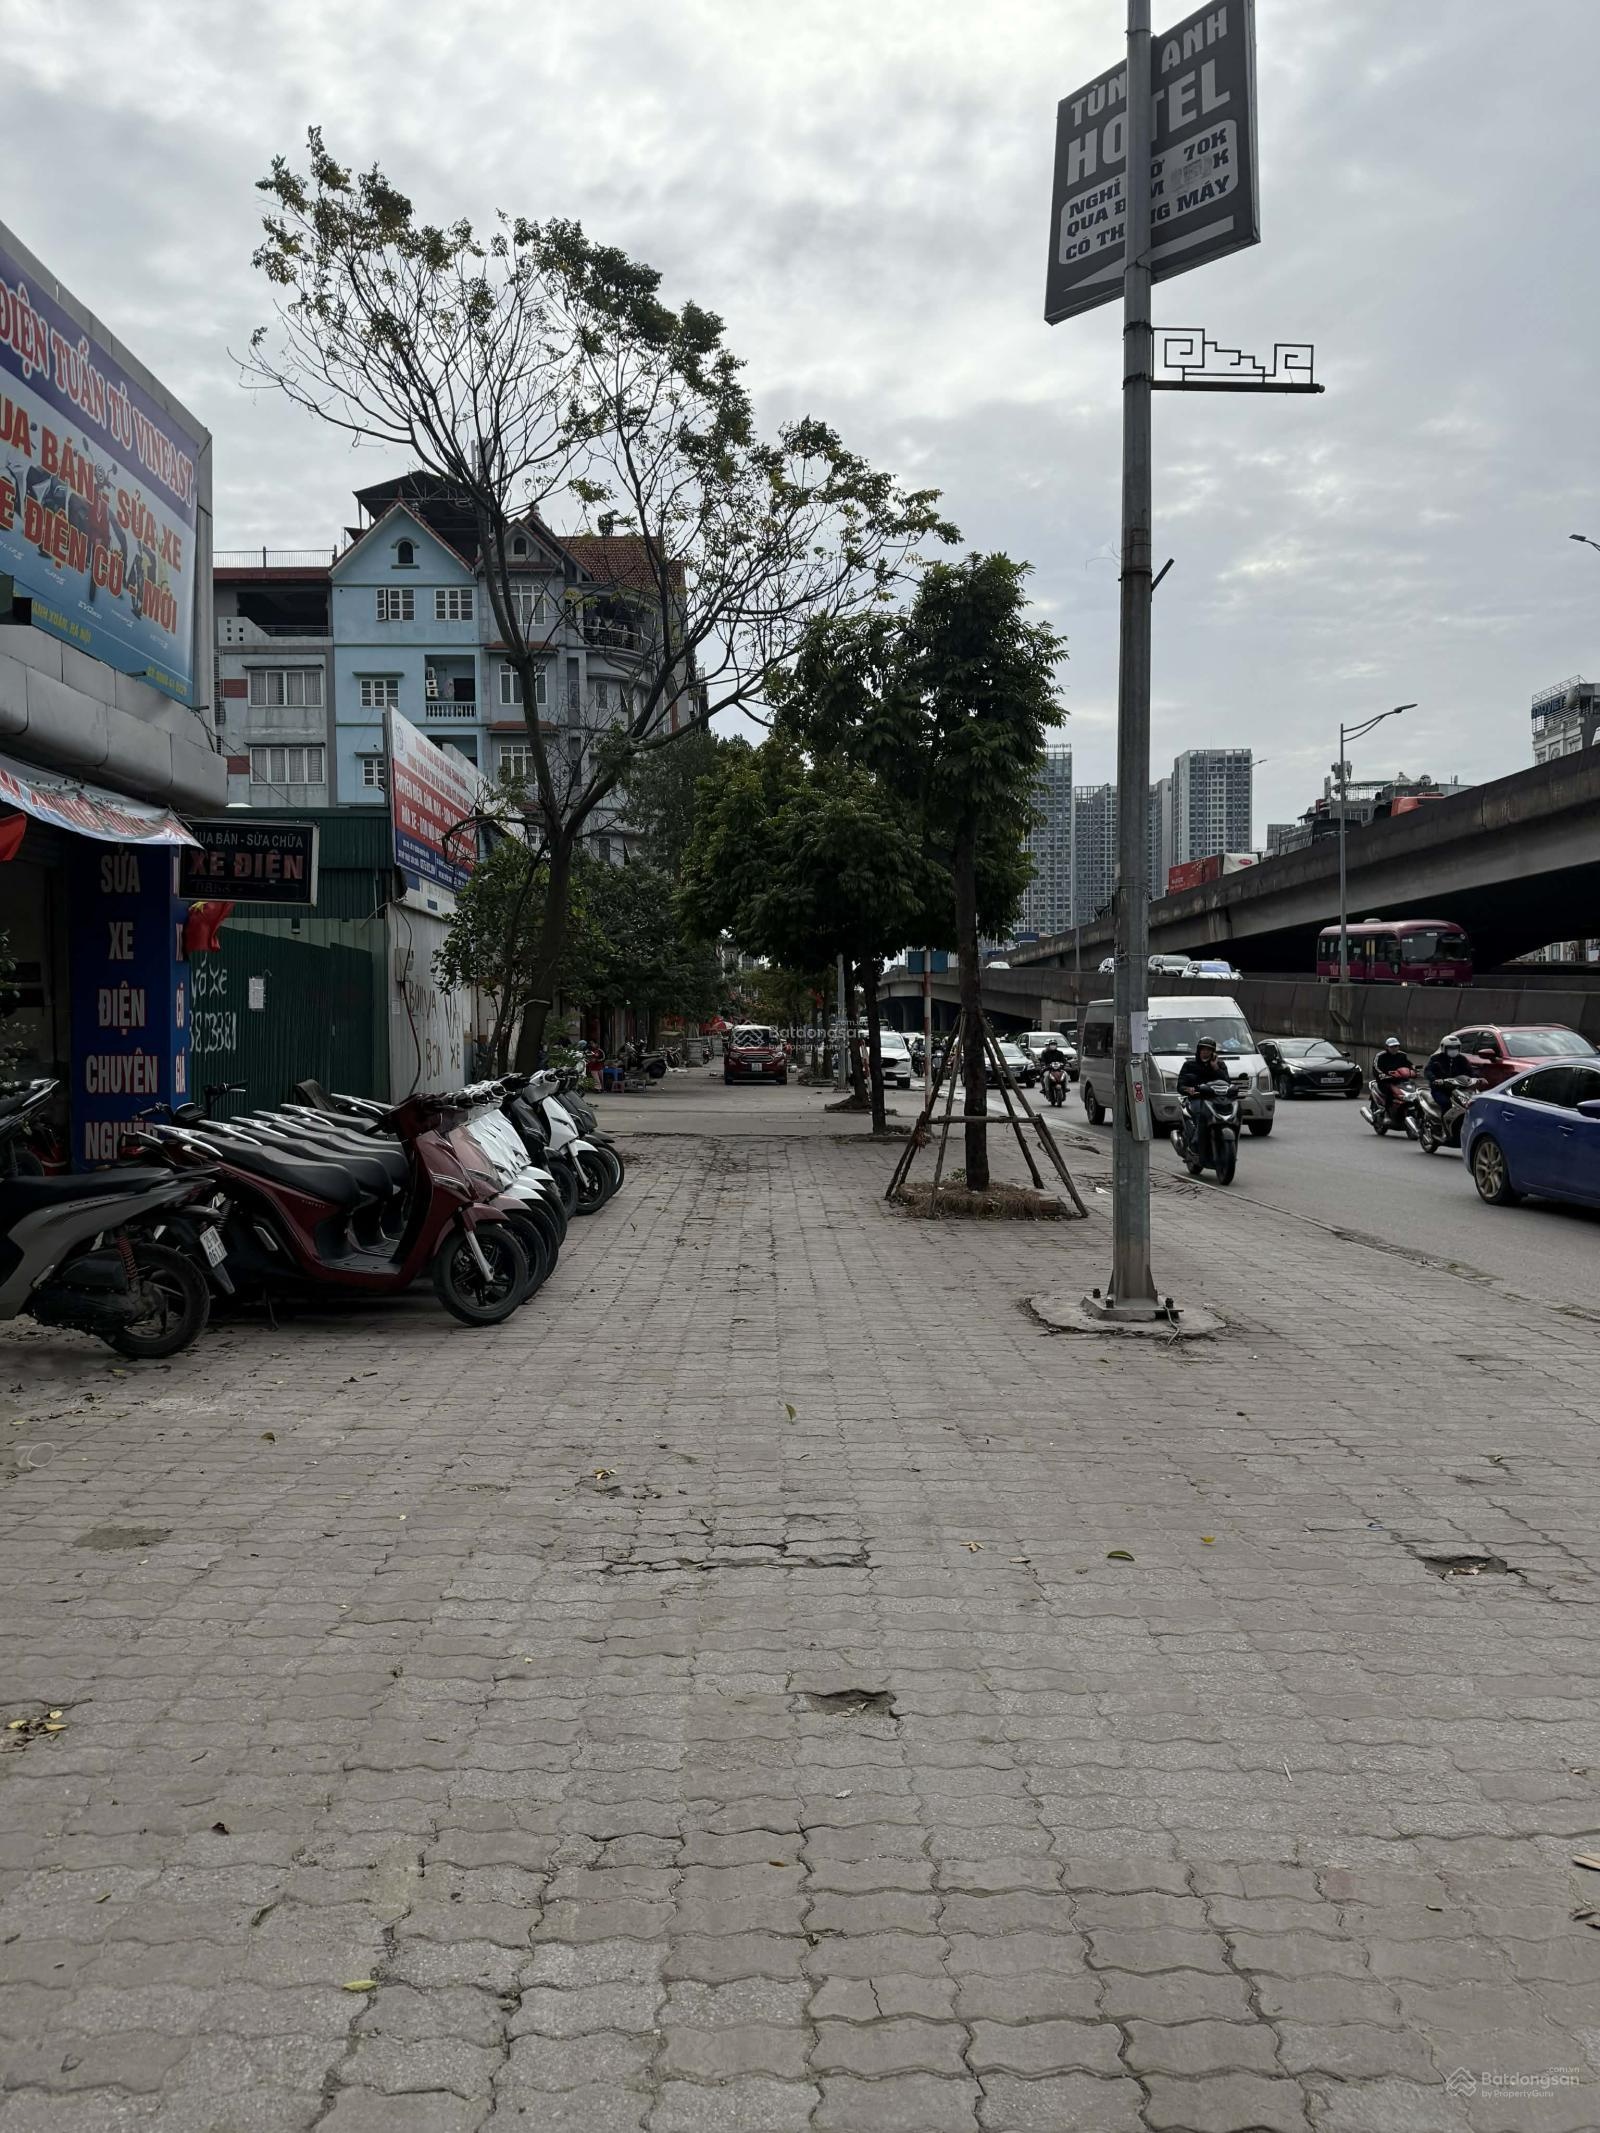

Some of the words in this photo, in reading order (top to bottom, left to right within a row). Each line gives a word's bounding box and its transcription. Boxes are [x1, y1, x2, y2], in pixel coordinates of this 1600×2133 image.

[1071, 71, 1127, 127] TÙN
[1161, 6, 1228, 74] ANH
[1068, 177, 1122, 218] NGHỈ
[1183, 127, 1228, 162] 70K
[1065, 235, 1091, 261] CÓ
[1176, 174, 1230, 213] MÁY
[1066, 206, 1109, 237] QUA
[0, 396, 32, 459] UA
[42, 425, 96, 506] BÁN
[161, 523, 183, 574] XE
[133, 406, 194, 509] VINFAST
[0, 476, 16, 530] E
[24, 494, 88, 575] ĐIỆN
[92, 544, 125, 599] CŨ
[142, 578, 178, 636] MỚI
[190, 850, 227, 877] XE
[216, 829, 239, 846] BÁN
[246, 830, 271, 848] SỬA
[272, 832, 304, 849] CHỮA
[100, 843, 142, 894] SỬA
[108, 921, 135, 961] XE
[97, 981, 146, 1036] ĐIỆN
[85, 1047, 158, 1095] CHUYÊN
